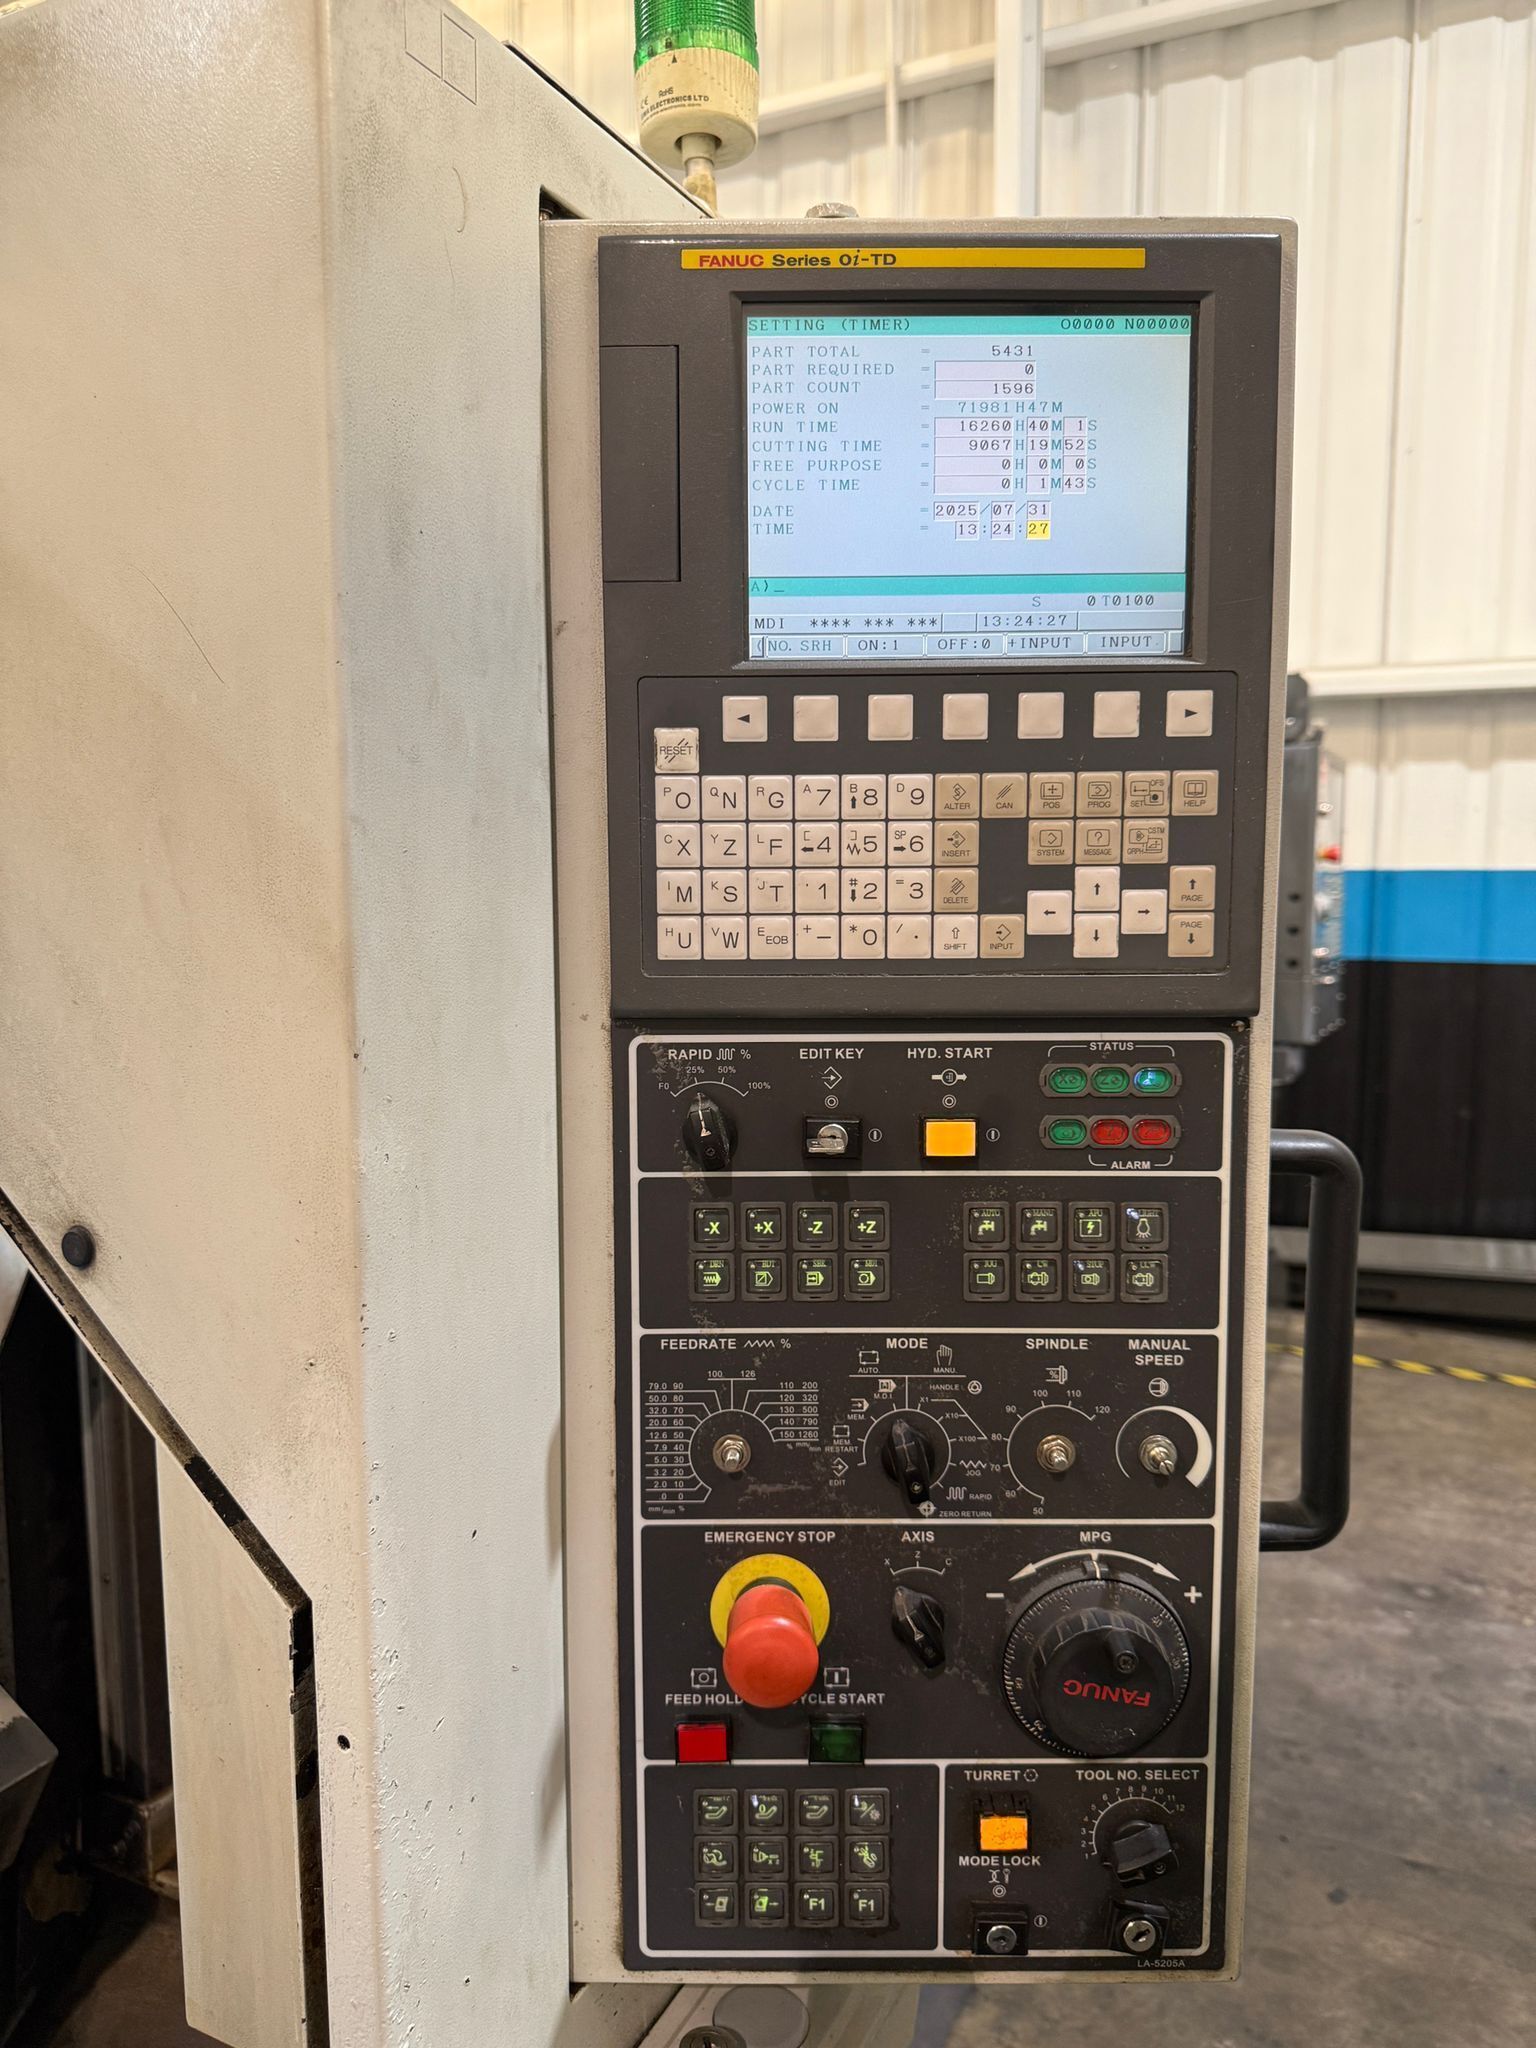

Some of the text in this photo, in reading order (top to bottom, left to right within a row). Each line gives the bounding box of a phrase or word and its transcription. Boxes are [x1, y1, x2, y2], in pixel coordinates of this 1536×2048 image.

[699, 255, 764, 267] FANUC
[772, 254, 831, 267] Series
[748, 318, 911, 331] SETTING (TIMER)
[1124, 318, 1189, 330] N00000
[752, 345, 1033, 358] PART TOTAL 5431
[752, 363, 894, 376] PART REQUIRED
[752, 382, 1034, 394] PART COUNT 1596
[752, 403, 805, 414] POWER
[817, 402, 839, 414] ON
[752, 422, 783, 433] RUN
[797, 421, 838, 433] TIME
[752, 441, 827, 452] CUTTING
[841, 440, 882, 452] TIME
[752, 460, 882, 471] FREE PURPOSE
[752, 479, 860, 491] CYCLE TIME
[753, 504, 794, 517] DATE
[753, 522, 794, 535] TIME
[1102, 595, 1154, 606] T0100
[754, 615, 1067, 629] MDI 13:24:27
[768, 640, 832, 651] NO. SRH
[858, 640, 898, 650] ON:1
[937, 638, 991, 651] OFF:0
[1008, 637, 1072, 649] +INPUT
[1101, 636, 1152, 648] INPUT
[660, 746, 693, 755] RESET
[723, 792, 736, 808] N
[768, 792, 784, 808] G
[816, 789, 831, 806] 7
[863, 789, 878, 805] 8
[910, 788, 924, 805] 9
[677, 840, 691, 856] X
[724, 840, 737, 855] Z
[770, 839, 782, 855] F
[816, 836, 831, 853] 4
[863, 836, 878, 852] 5
[910, 836, 924, 852] 6
[677, 886, 692, 902] M
[724, 886, 738, 902] S
[770, 886, 784, 902] T
[863, 882, 878, 899] 2
[909, 882, 924, 899] 3
[678, 932, 691, 948] U
[722, 932, 739, 948] W
[766, 936, 788, 944] EOB
[1089, 1042, 1134, 1051] STATUS
[668, 1049, 712, 1060] RAPID
[799, 1048, 864, 1059] EDIT KEY
[907, 1048, 993, 1059] HYD. START
[686, 1066, 705, 1074] 25%
[718, 1066, 736, 1074] 50%
[748, 1082, 771, 1090] 100%
[1111, 1161, 1151, 1169] ALARM
[704, 1222, 720, 1234] -X
[754, 1222, 774, 1234] +X
[808, 1221, 823, 1234] -Z
[857, 1221, 876, 1233] +Z
[661, 1339, 737, 1350] FEEDRATE
[886, 1338, 928, 1349] MODE
[1025, 1339, 1089, 1350] SPINDLE
[1128, 1339, 1191, 1350] MANUAL
[1135, 1355, 1184, 1365] SPEED
[1005, 1405, 1016, 1413] 90
[991, 1433, 1001, 1441] 80
[1033, 1507, 1043, 1515] 50
[704, 1531, 836, 1542] EMERGENCY STOP
[901, 1531, 935, 1542] AXIS
[1080, 1531, 1111, 1542] MPG
[665, 1694, 703, 1704] FEED
[792, 1694, 885, 1704] YCLE START
[1063, 1679, 1151, 1707] FANUC
[964, 1770, 1021, 1780] TURRET
[1076, 1770, 1200, 1780] TOOL NO. SELECT
[959, 1856, 1041, 1866] MODE LOCK
[809, 1898, 825, 1911] F1
[859, 1900, 874, 1911] F1
[1137, 1960, 1185, 1968] LA-5205A
